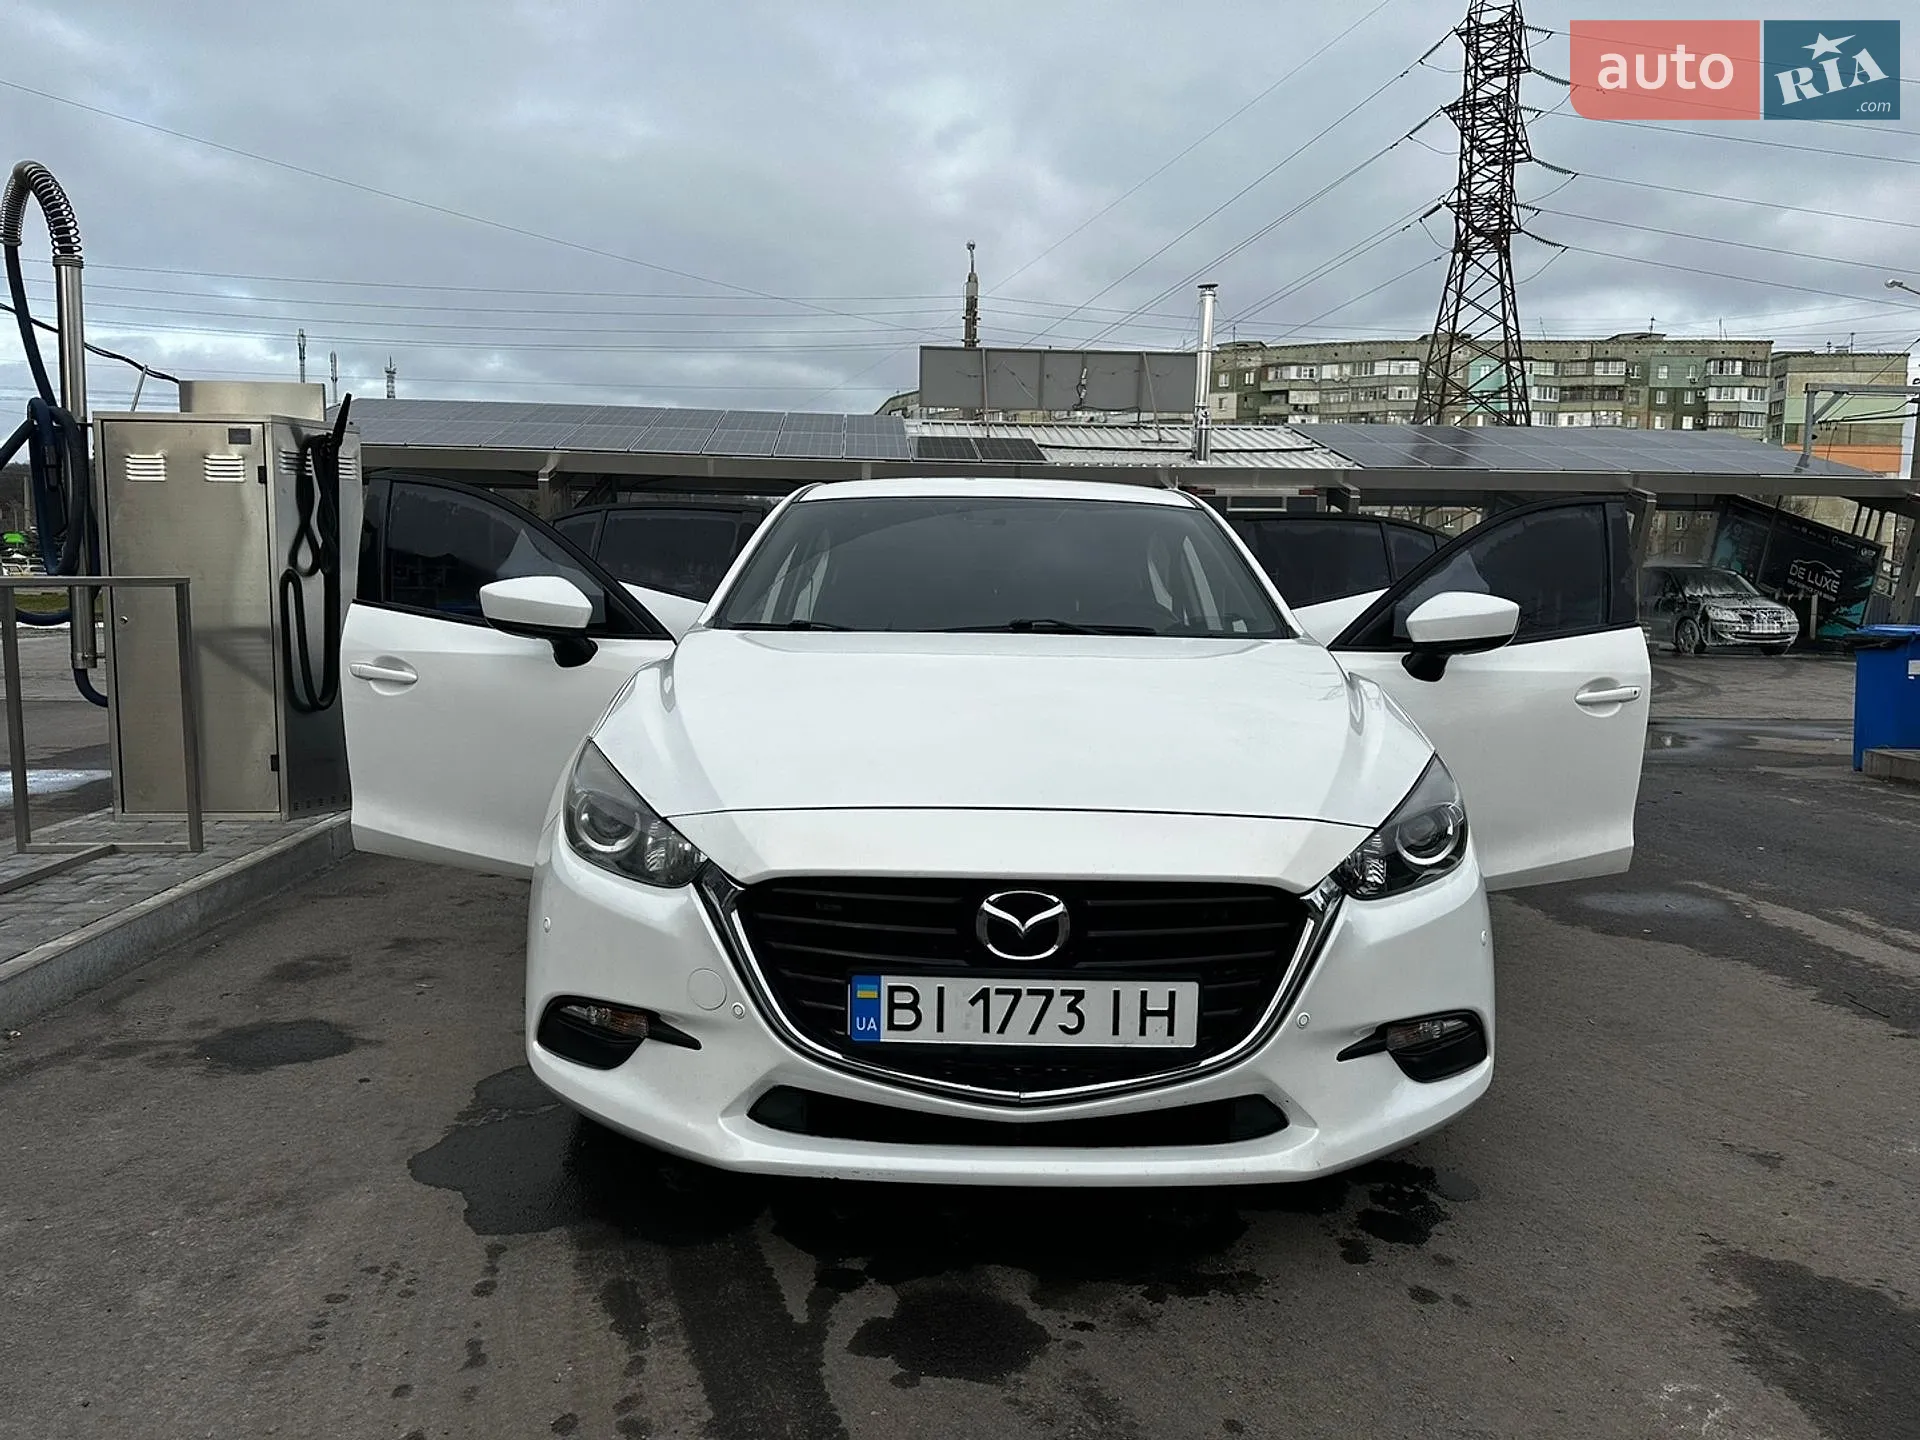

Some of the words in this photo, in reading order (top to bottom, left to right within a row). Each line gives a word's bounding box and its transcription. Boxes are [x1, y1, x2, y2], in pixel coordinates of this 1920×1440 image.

[1789, 563, 1806, 580] DE
[1807, 570, 1840, 593] LUXE
[855, 1016, 878, 1032] UA
[886, 984, 945, 1033] BI
[967, 986, 1086, 1035] 1773
[1111, 989, 1177, 1037] IH
